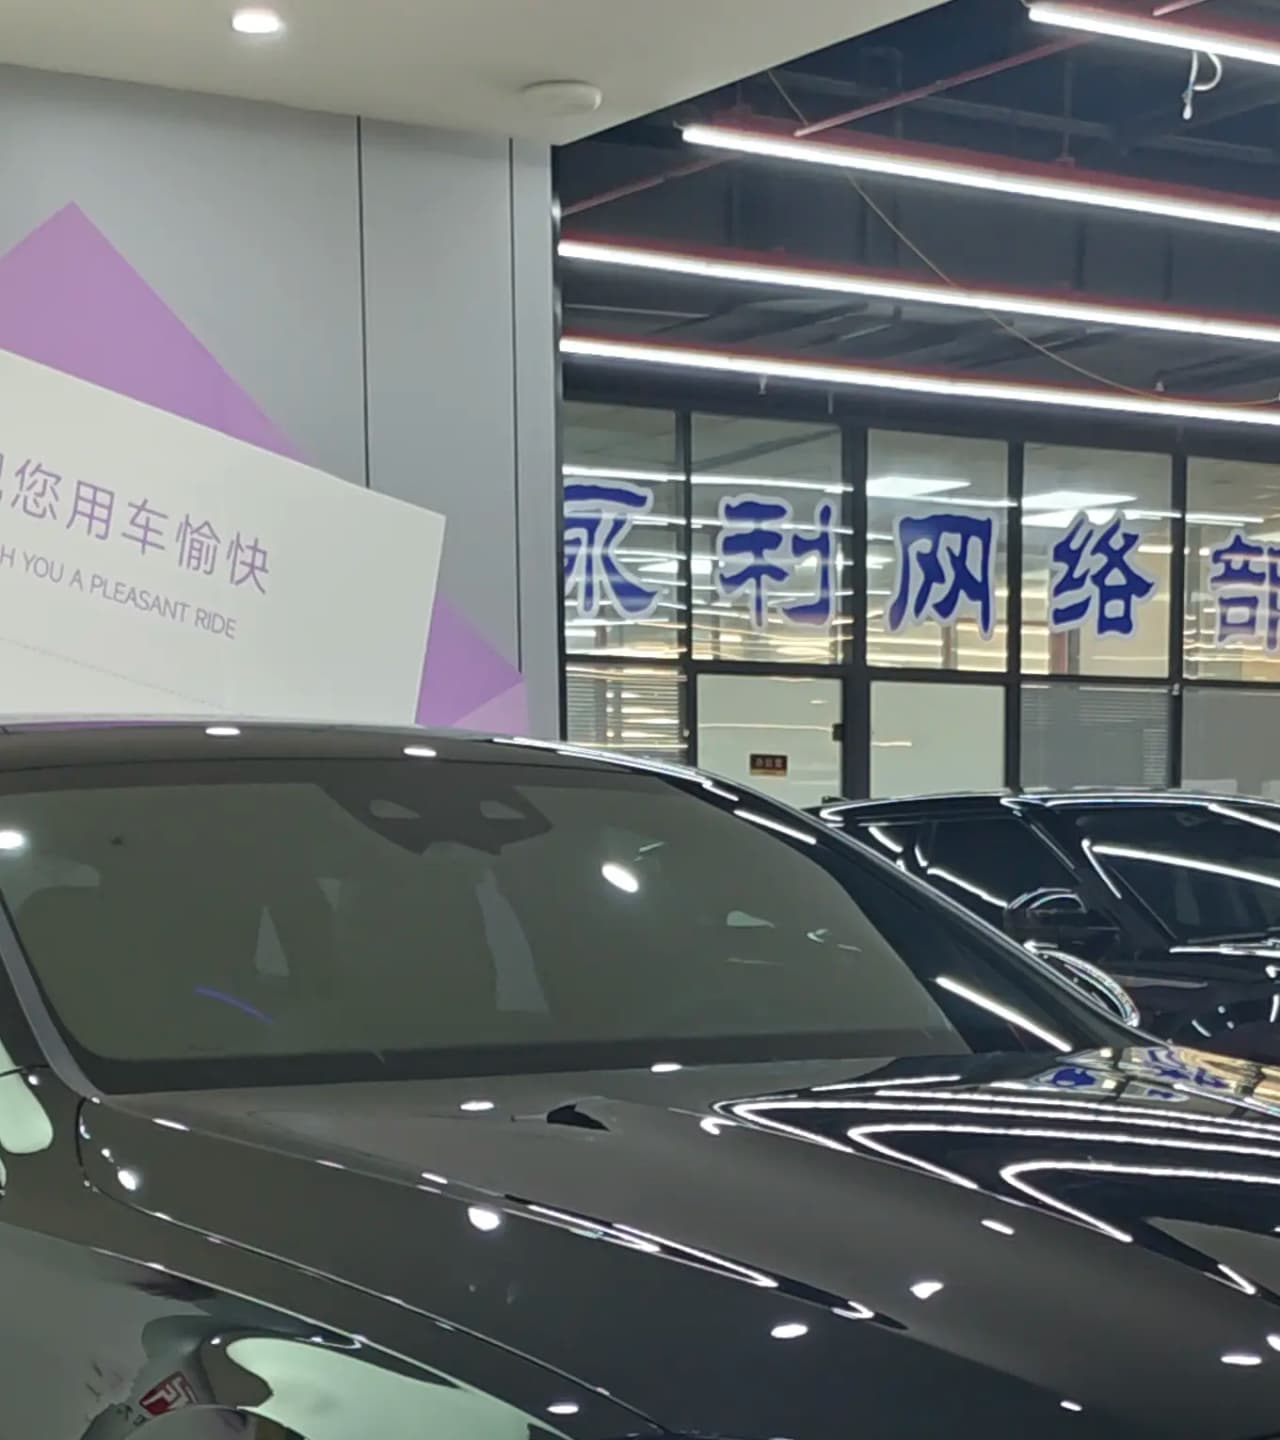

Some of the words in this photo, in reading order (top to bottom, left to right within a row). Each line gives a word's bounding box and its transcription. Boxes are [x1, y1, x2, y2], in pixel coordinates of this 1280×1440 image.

[22, 549, 65, 585] YOU
[69, 568, 84, 593] A
[90, 574, 190, 625] PLEASANT
[194, 606, 237, 640] RIDE
